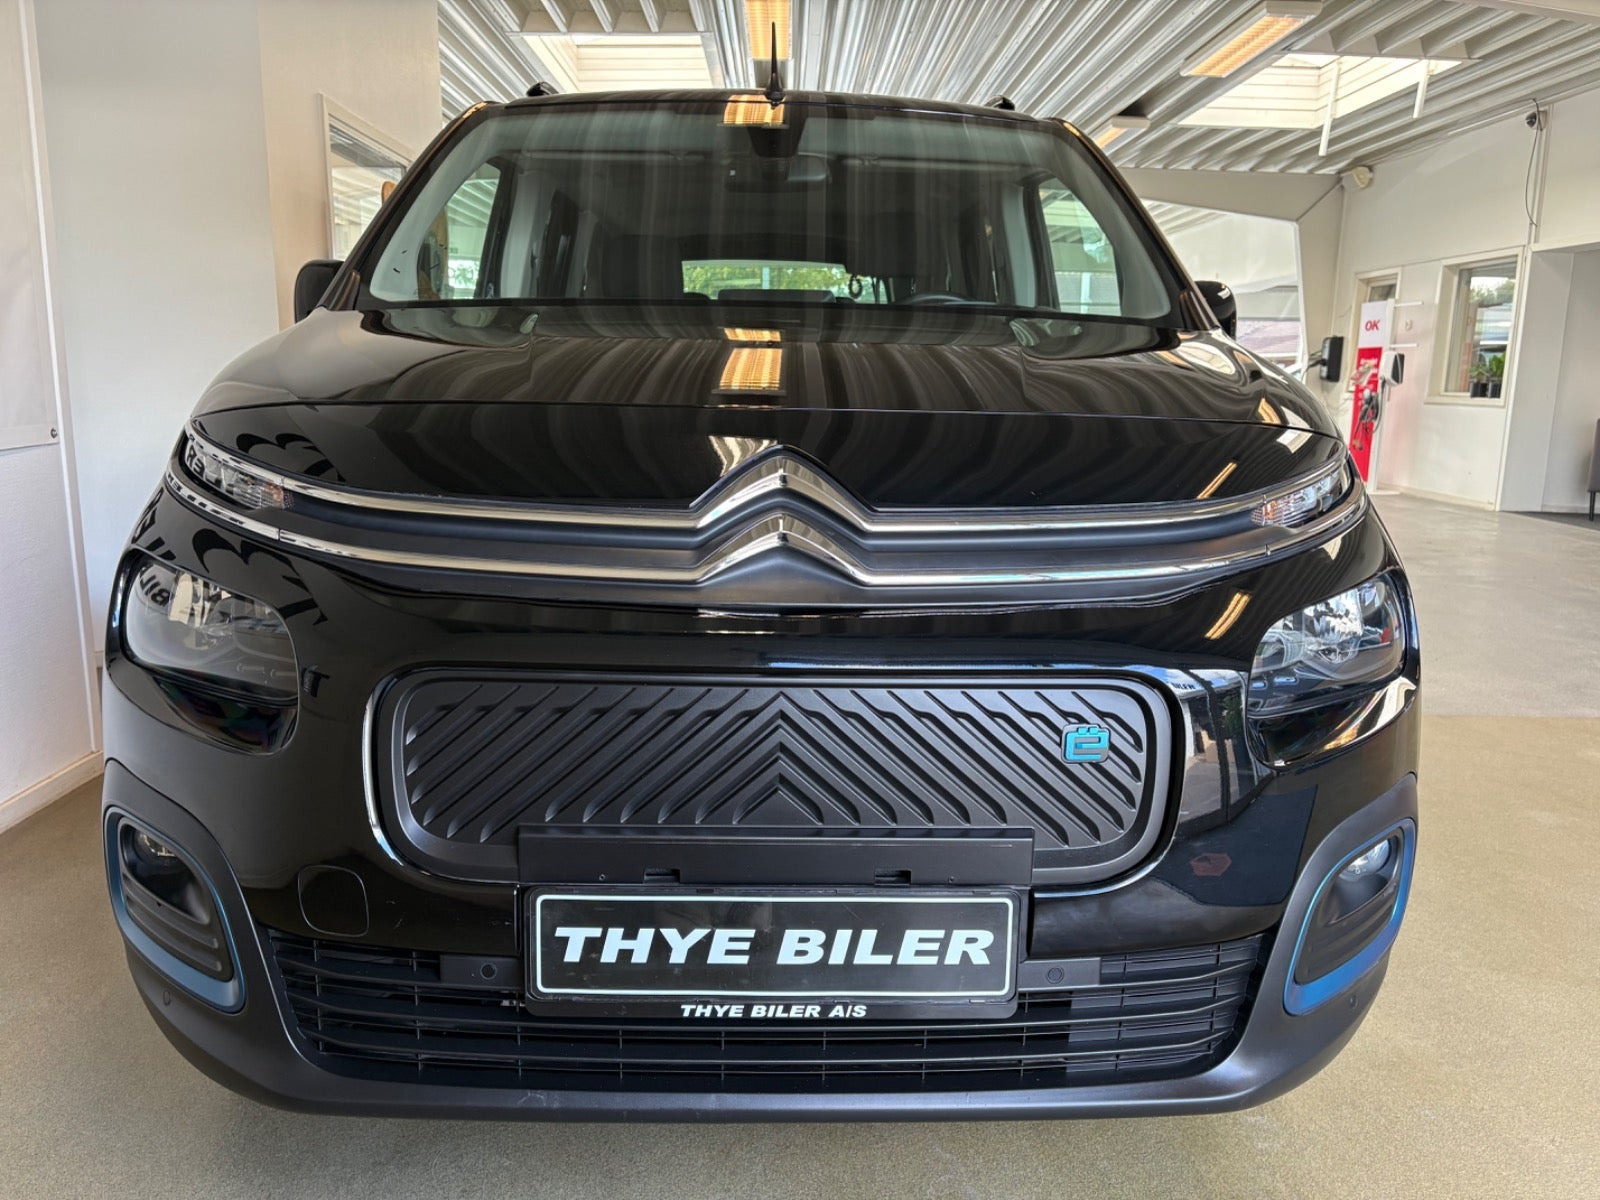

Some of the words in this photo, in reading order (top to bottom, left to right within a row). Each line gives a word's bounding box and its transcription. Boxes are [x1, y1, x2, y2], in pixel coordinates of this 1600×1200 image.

[1365, 320, 1380, 331] OK
[554, 926, 757, 965] THYE
[776, 928, 995, 966] BILER
[680, 1004, 744, 1018] THYE
[750, 1004, 821, 1018] BILER
[828, 1004, 868, 1018] A/S
